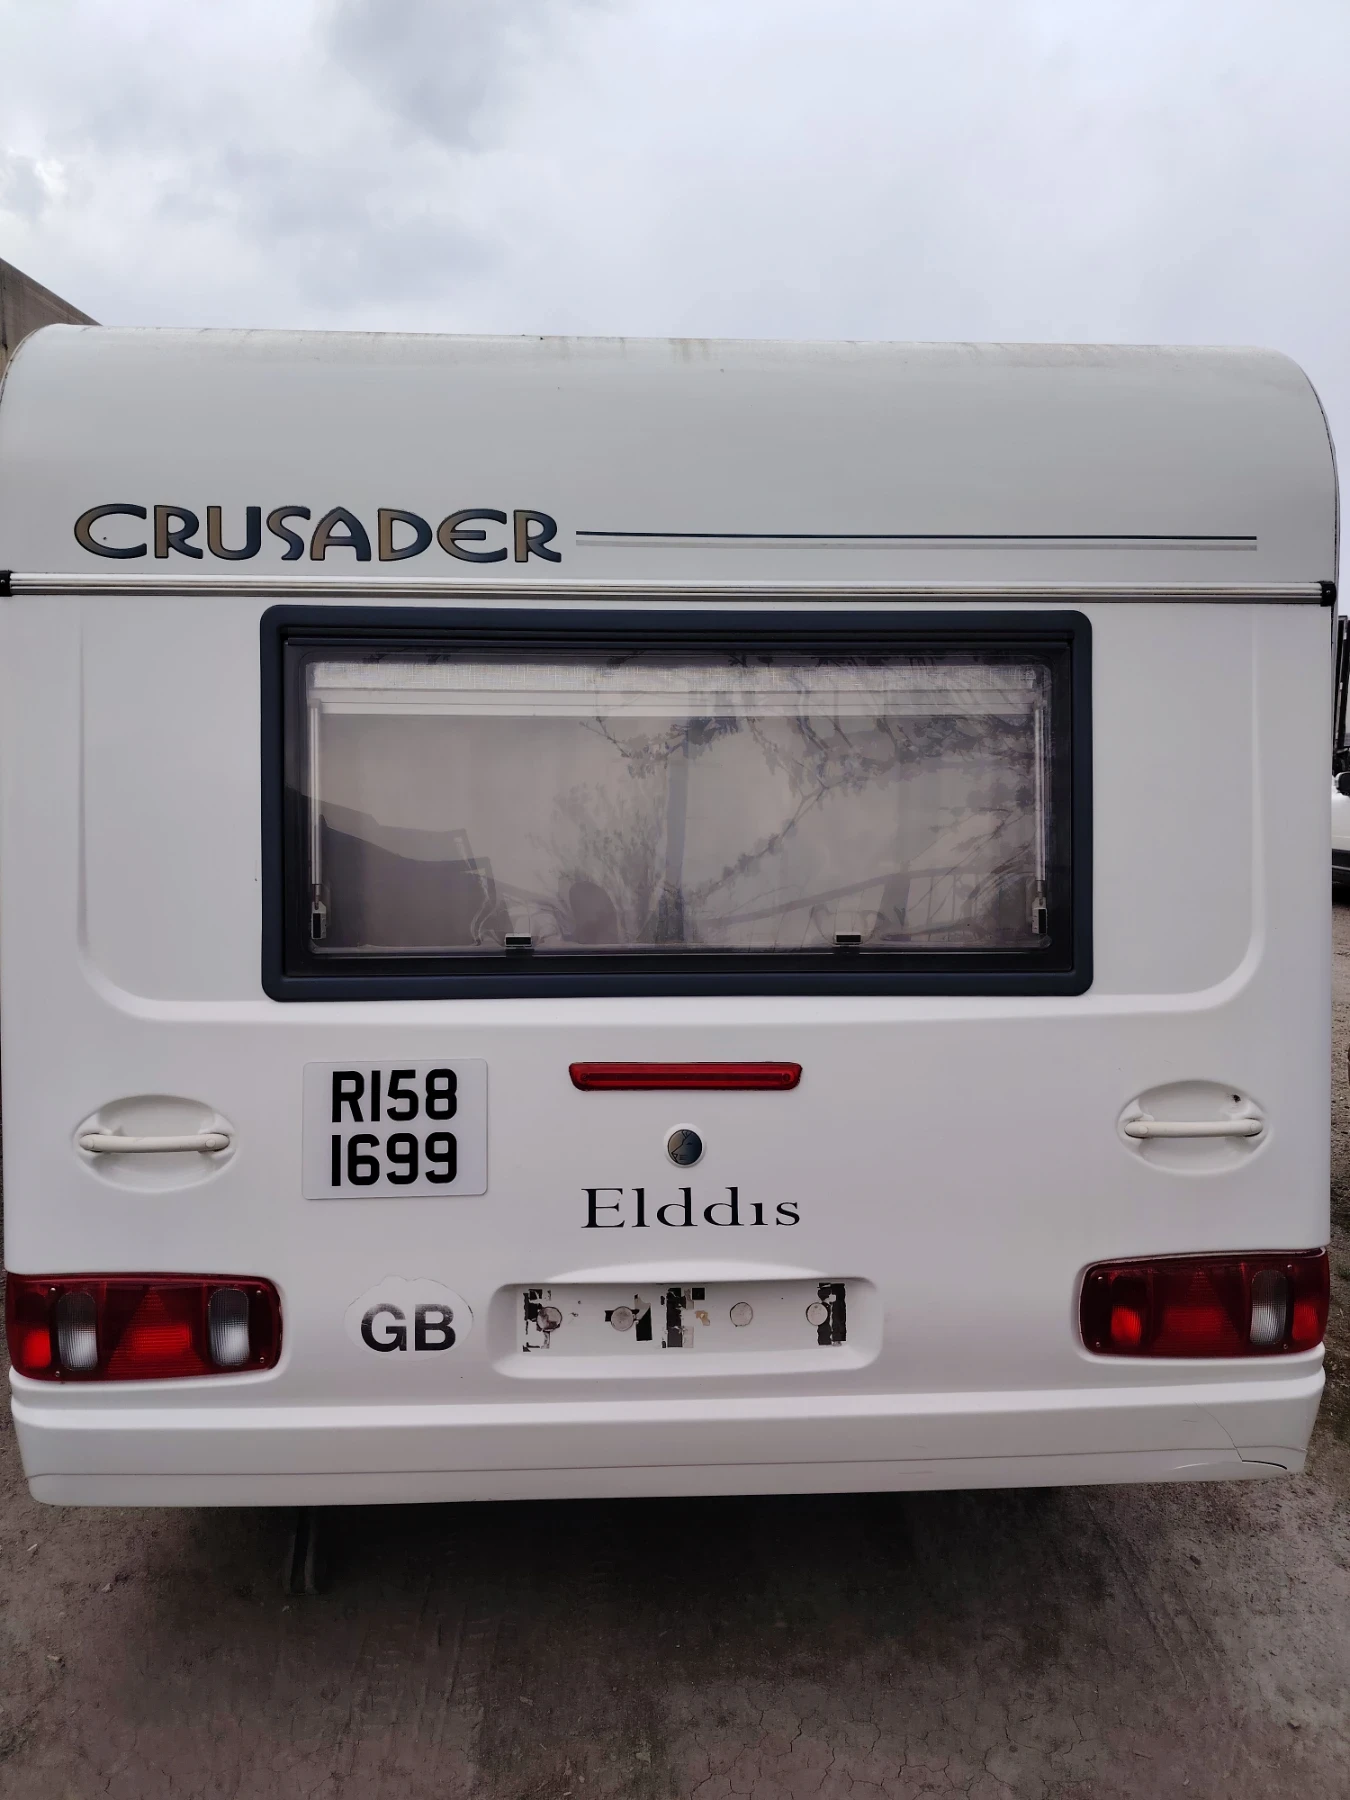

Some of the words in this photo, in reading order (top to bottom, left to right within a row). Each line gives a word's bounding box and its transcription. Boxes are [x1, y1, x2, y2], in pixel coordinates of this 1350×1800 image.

[74, 503, 562, 563] CRUSADER
[581, 1187, 801, 1228] Elddis
[360, 1303, 456, 1352] GB
